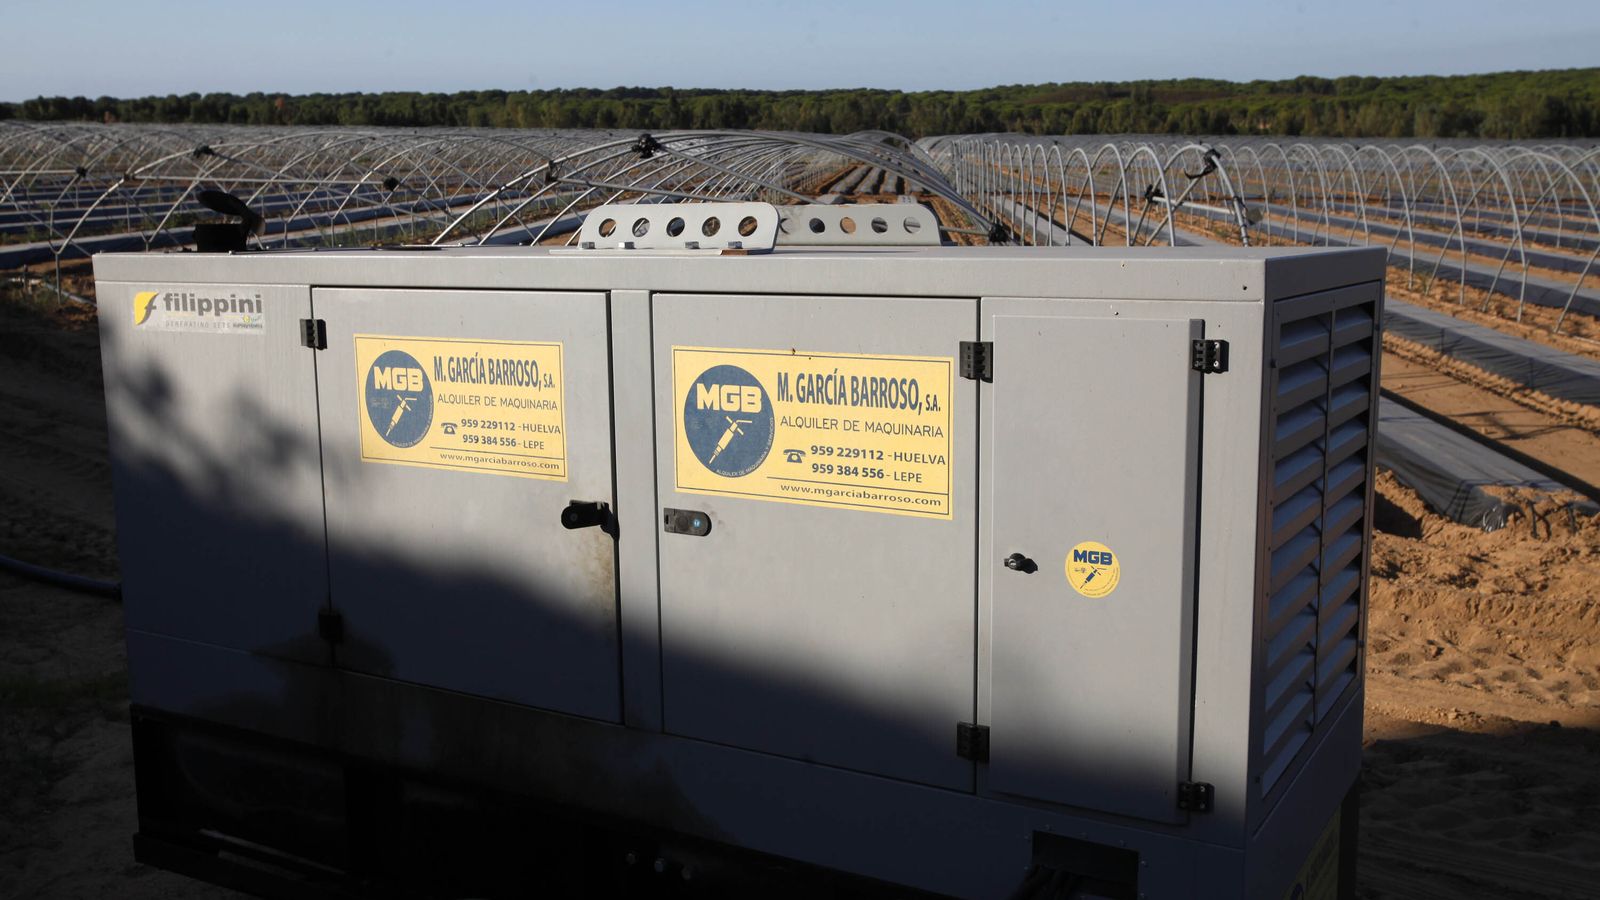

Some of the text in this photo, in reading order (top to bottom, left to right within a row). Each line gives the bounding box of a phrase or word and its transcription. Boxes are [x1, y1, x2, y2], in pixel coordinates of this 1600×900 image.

[163, 292, 263, 317] filippini
[373, 366, 424, 392] MGB
[434, 352, 556, 392] M. GARCÍA BARROSO, S.A.
[437, 393, 558, 411] ALQUILER DE MAQUINARIA
[696, 383, 762, 413] MGB
[777, 368, 941, 416] M. GARCÍA BARROSO, S.A.
[461, 419, 479, 428] 959
[480, 420, 516, 431] 229112
[780, 415, 944, 438] ALQUILER DE MAQUINARIA
[462, 434, 479, 444] 959
[481, 435, 498, 446] 384
[499, 437, 517, 447] 556
[523, 440, 545, 450] LEPE
[439, 453, 560, 470] www.mgarciabarroso.com
[810, 445, 834, 456] 959
[836, 447, 884, 461] 229112
[811, 463, 834, 474] 959
[836, 465, 859, 477] 384
[861, 467, 884, 479] 556
[893, 471, 923, 483] LEPE
[780, 484, 942, 507] www.mgarciabarroso.com
[1073, 549, 1113, 566] MGB
